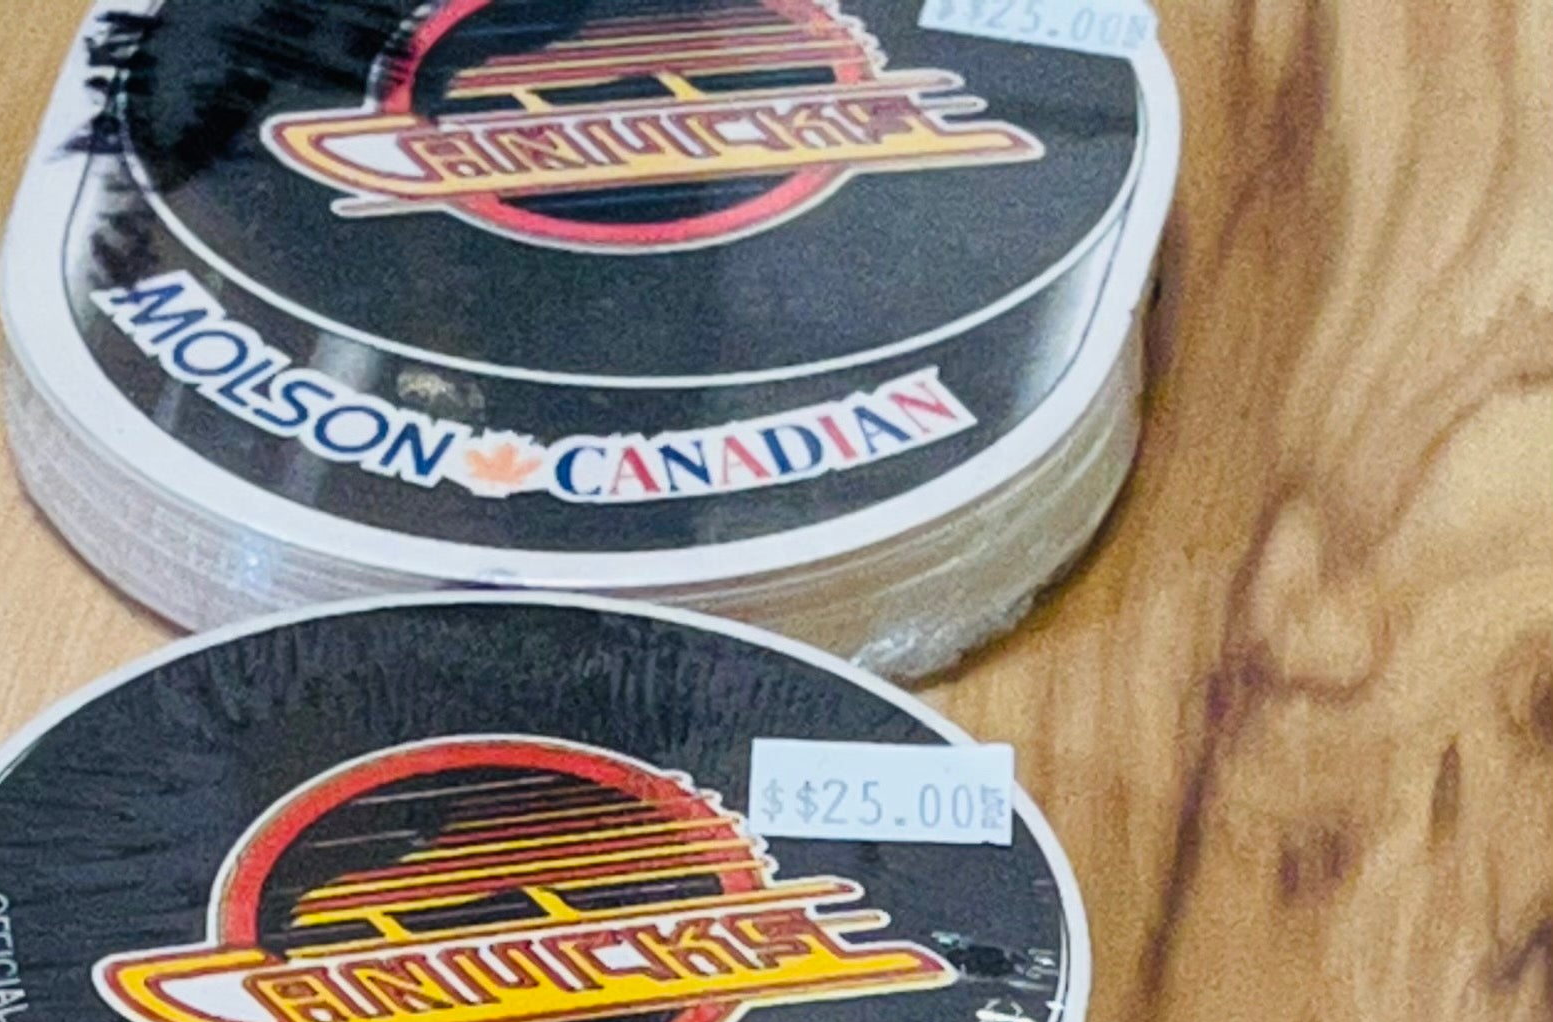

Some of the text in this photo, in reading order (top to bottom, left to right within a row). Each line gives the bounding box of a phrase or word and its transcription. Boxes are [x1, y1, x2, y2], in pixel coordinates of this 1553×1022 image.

[272, 92, 957, 200] CANUCKS
[110, 281, 960, 497] MOLSON CANADIAN
[760, 778, 974, 829] $$25.00
